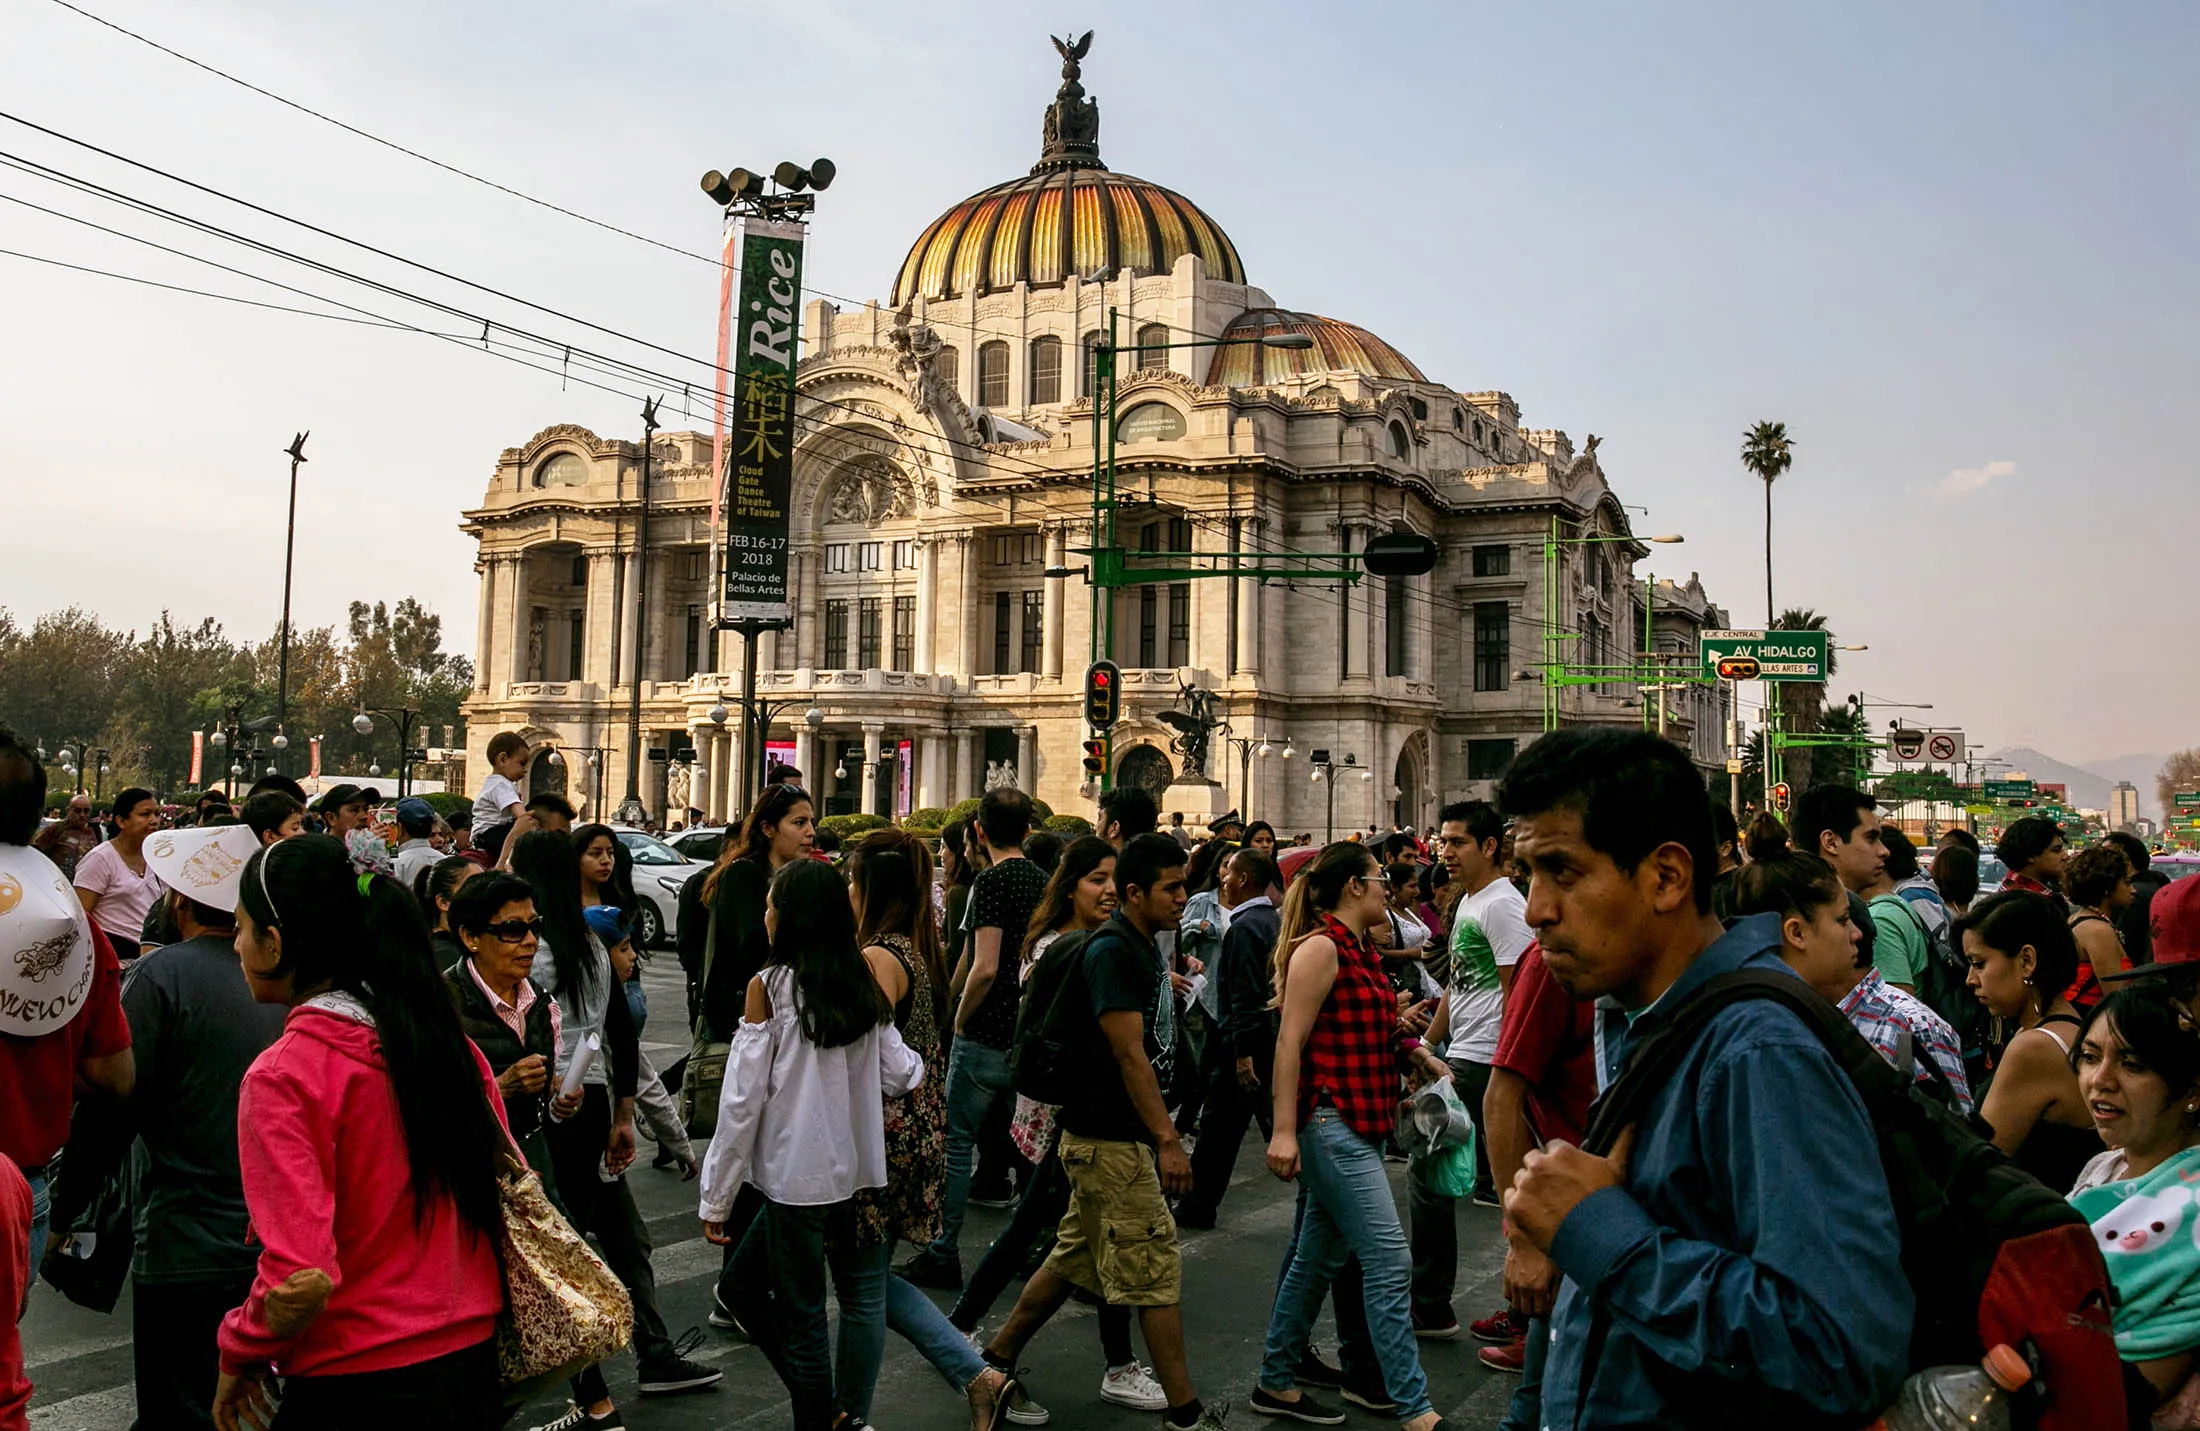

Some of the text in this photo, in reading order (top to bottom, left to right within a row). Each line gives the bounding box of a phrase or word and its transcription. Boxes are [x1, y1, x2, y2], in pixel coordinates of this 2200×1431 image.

[749, 249, 795, 371] Rice
[740, 465, 764, 476] Cloud
[739, 475, 760, 487] Gate
[738, 486, 765, 497] Dance
[737, 496, 772, 508] Theatre
[737, 506, 781, 519] of Taiwan
[729, 534, 786, 550] FEB 16-17
[741, 552, 773, 566] 2018
[732, 571, 781, 583] Palacio de
[727, 583, 785, 595] Bellas Artes
[1733, 645, 1817, 658] AV HIDALGO
[1761, 665, 1803, 673] LLAS ARTES
